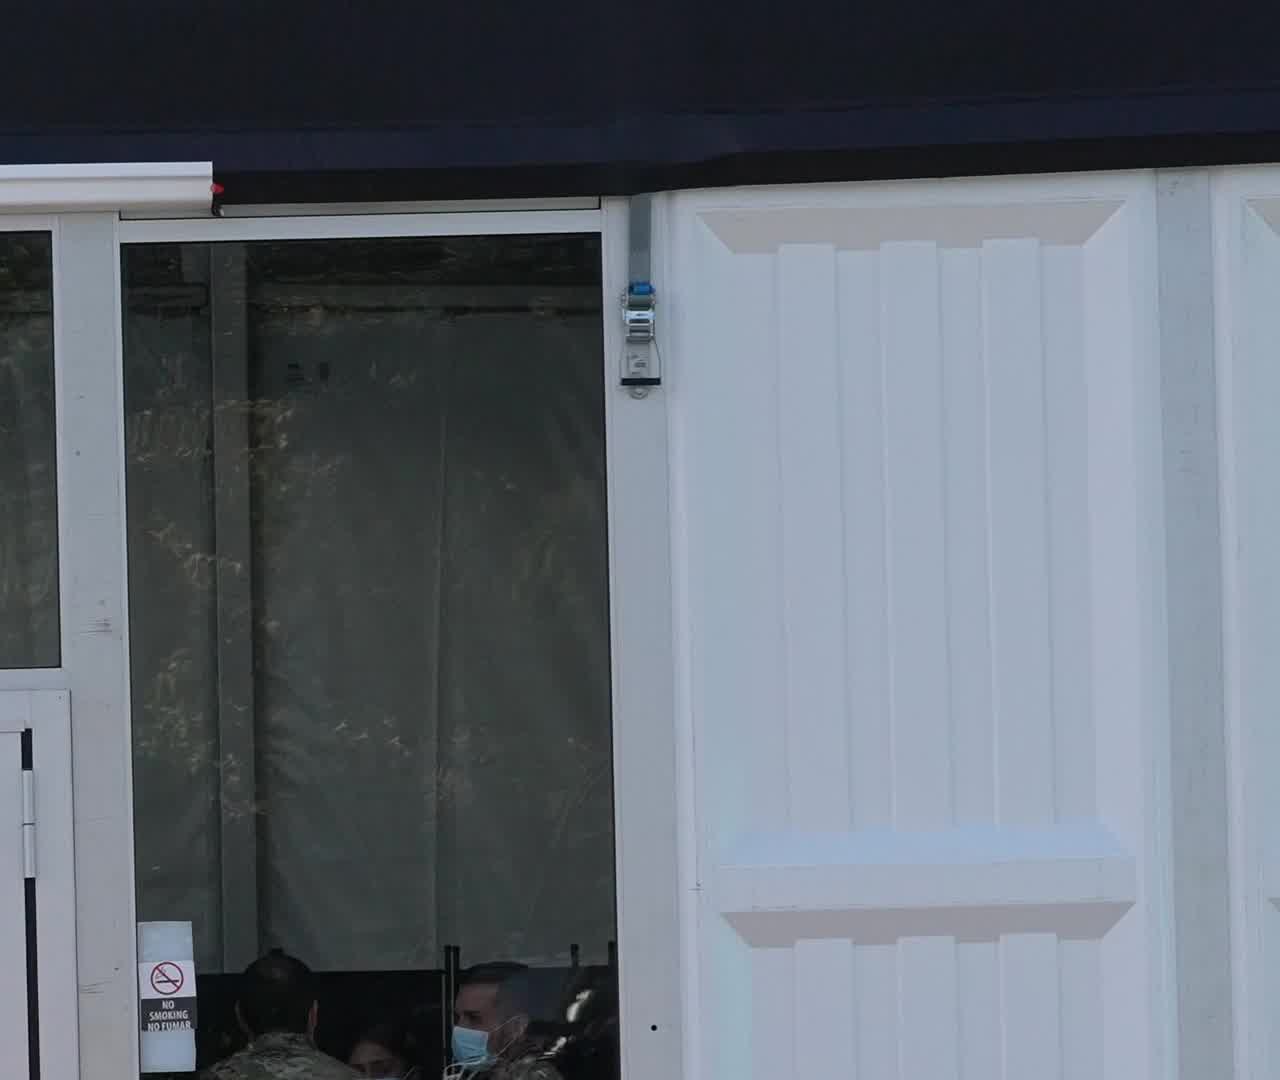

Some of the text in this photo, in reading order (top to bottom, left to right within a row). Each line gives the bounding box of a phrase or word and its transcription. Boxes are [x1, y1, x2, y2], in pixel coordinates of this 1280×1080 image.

[162, 1000, 174, 1010] NO
[149, 1010, 188, 1021] SMOKING
[147, 1021, 191, 1032] NO FUMAR
